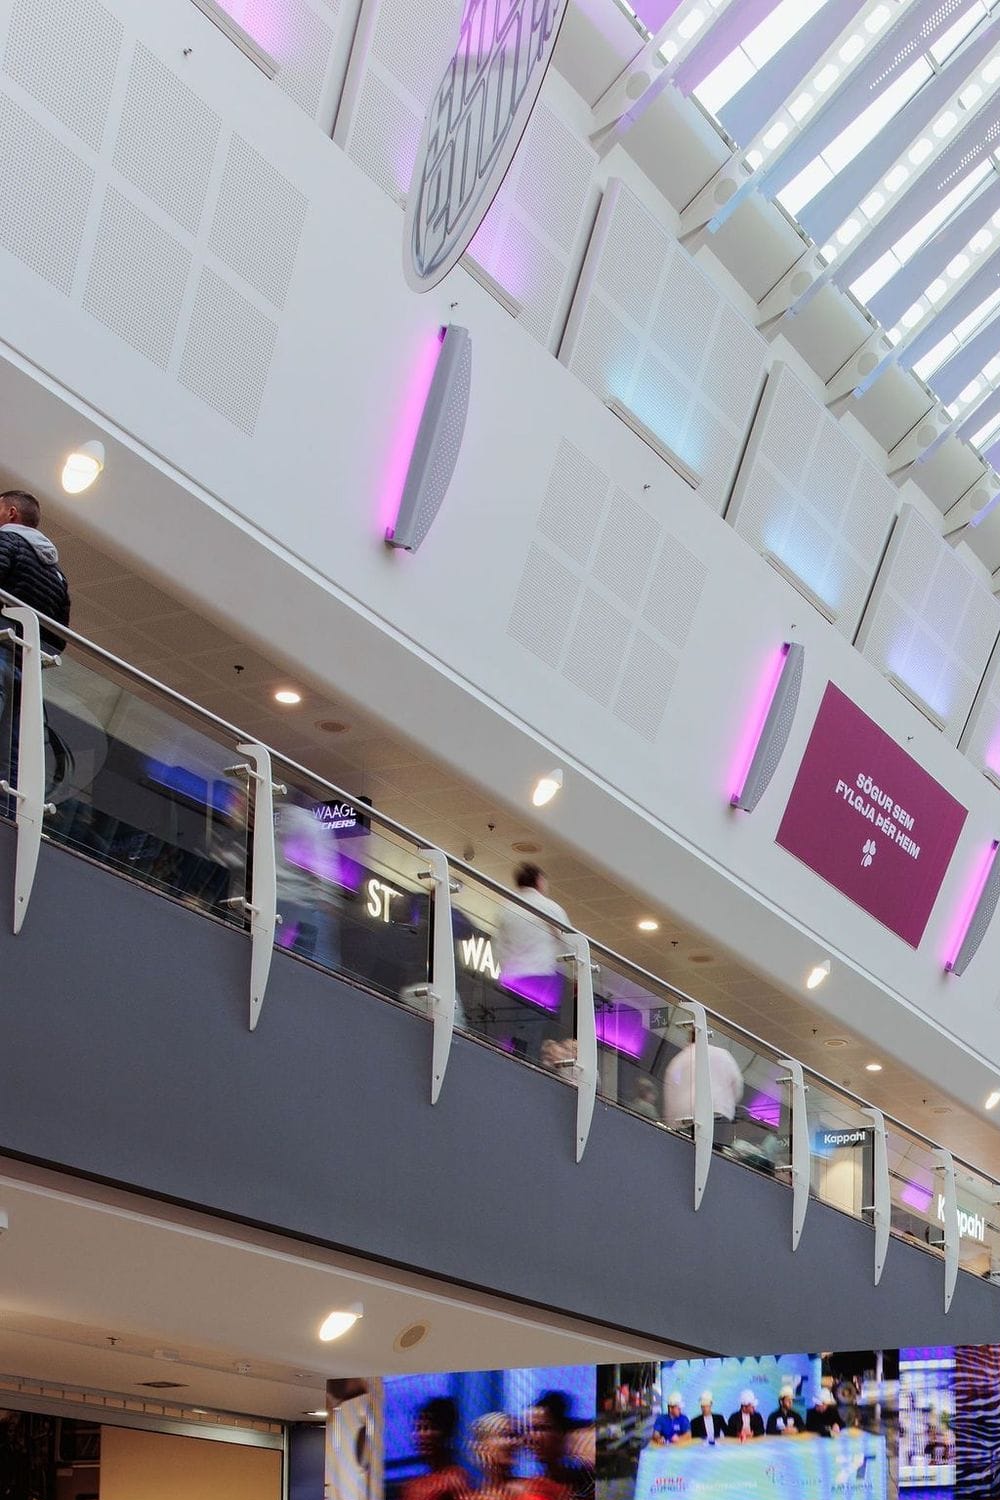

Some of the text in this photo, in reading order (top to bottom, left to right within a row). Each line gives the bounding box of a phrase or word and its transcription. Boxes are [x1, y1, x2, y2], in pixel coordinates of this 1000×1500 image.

[835, 779, 921, 860] FYLGJA ÞÉR HEIM
[856, 773, 915, 831] SÖGUR SEM
[823, 1130, 867, 1145] Kappahl
[937, 1194, 985, 1242] Kpahl
